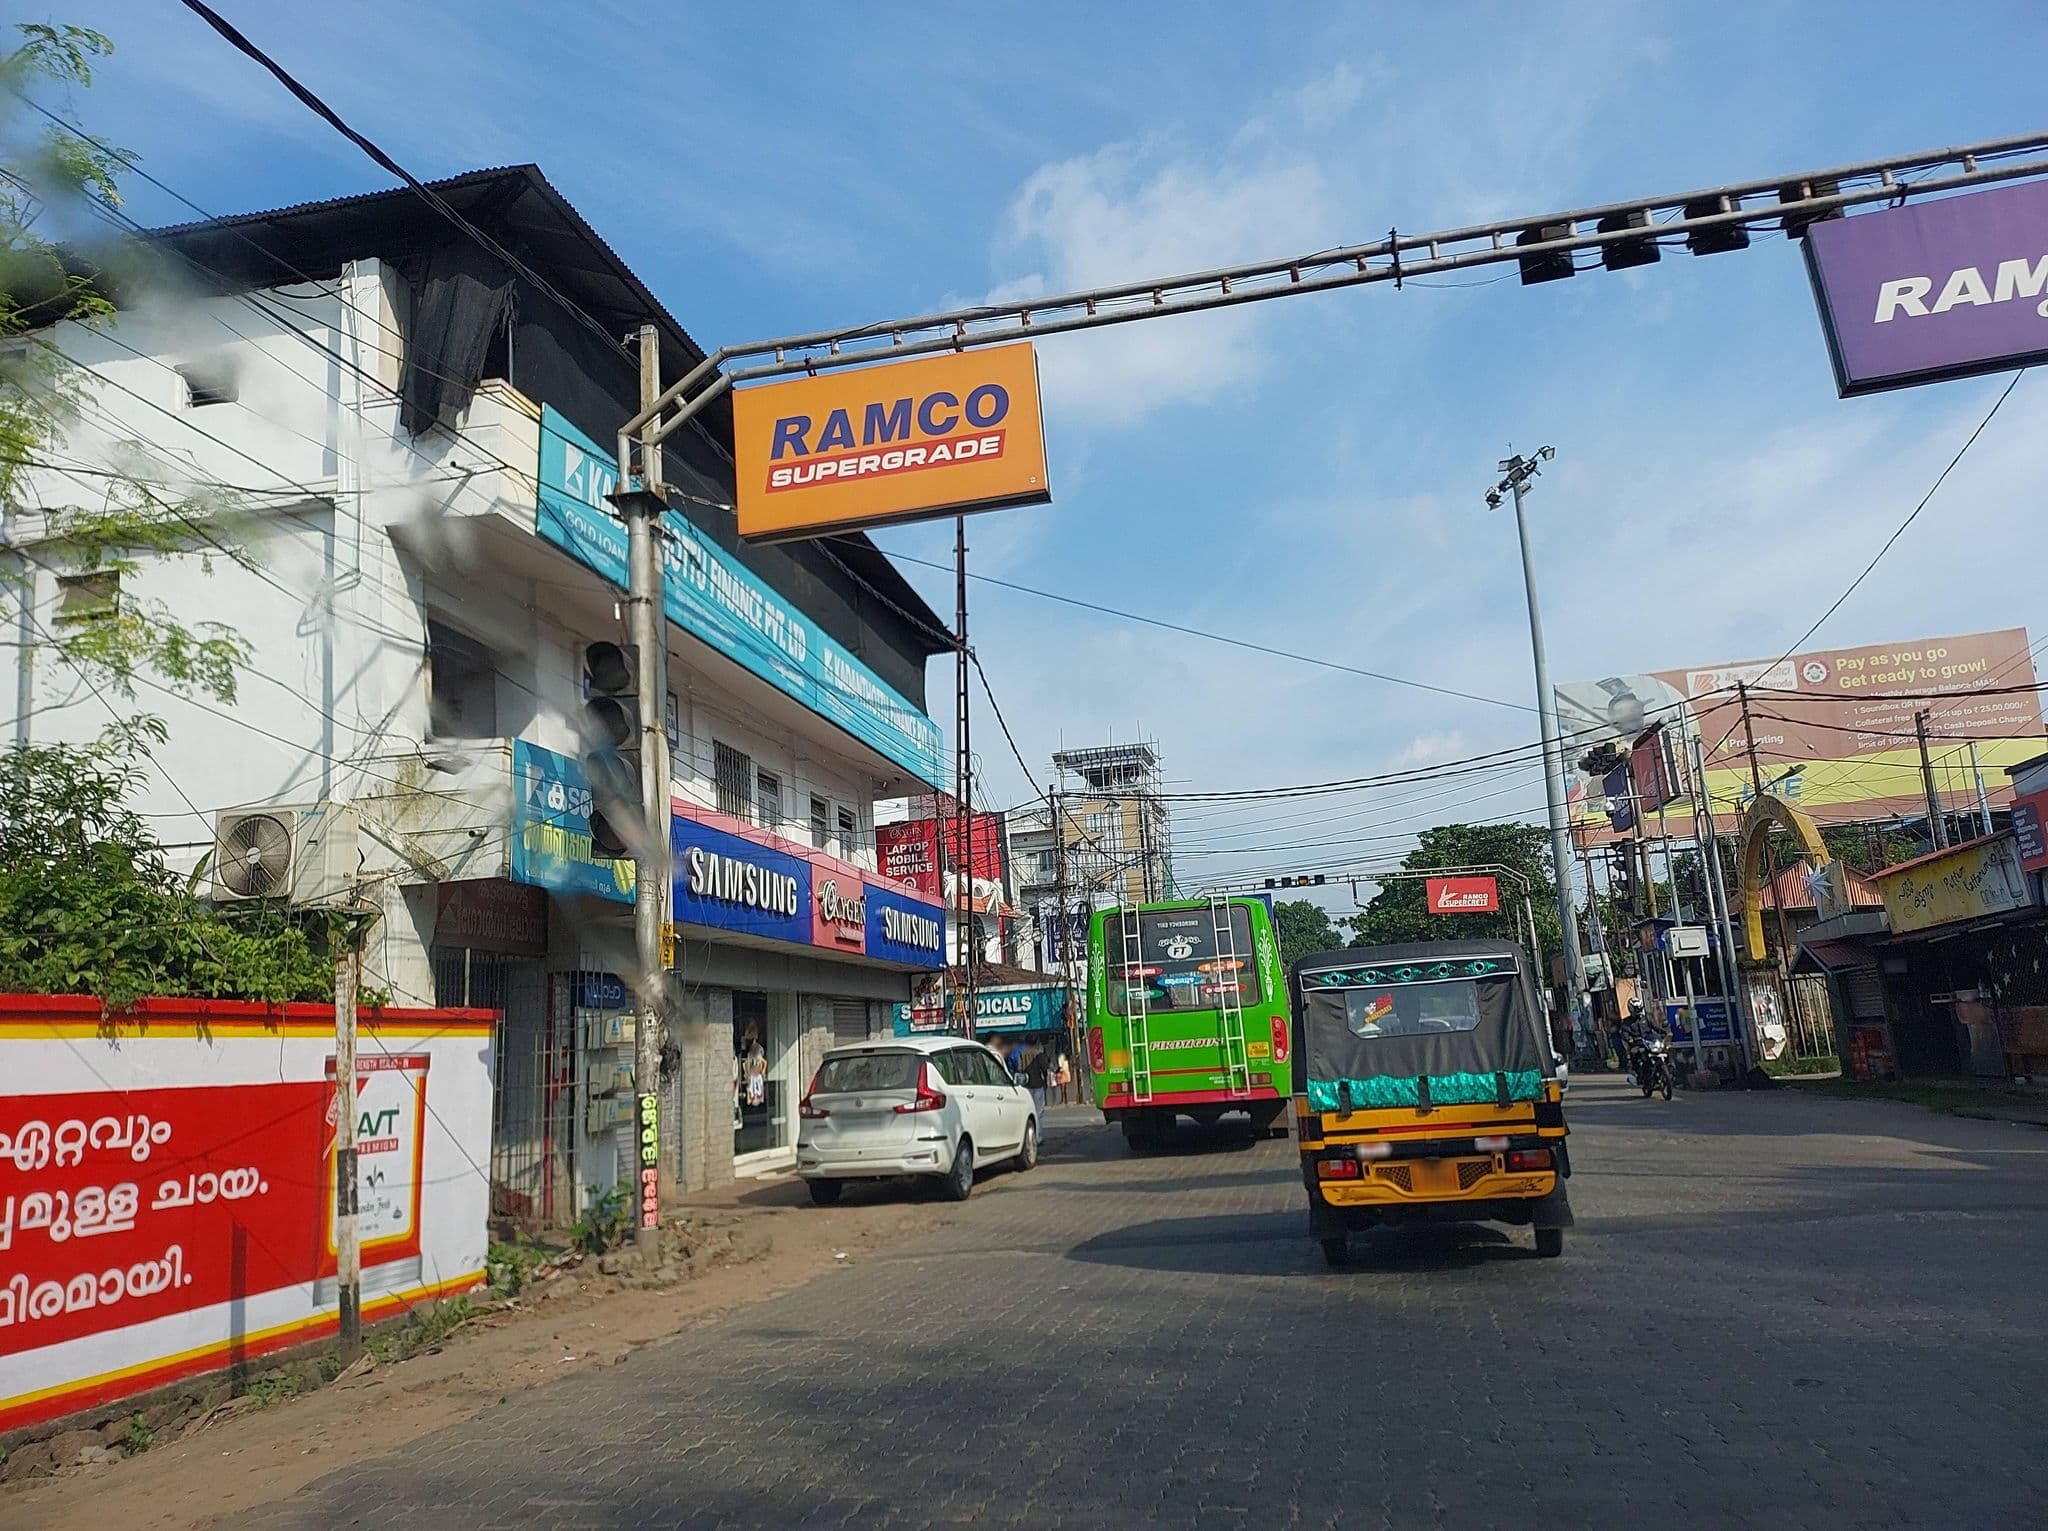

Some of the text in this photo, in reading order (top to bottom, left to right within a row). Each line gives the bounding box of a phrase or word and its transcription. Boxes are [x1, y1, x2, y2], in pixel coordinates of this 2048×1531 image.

[770, 383, 1010, 460] RAMCO
[771, 436, 1001, 488] SUPERGRADE
[565, 509, 596, 541] GOLD
[710, 557, 763, 632] FINANCE
[1836, 648, 1948, 672] Pay as you go
[1839, 658, 1988, 689] Get ready to grow!
[1904, 685, 1937, 696] Average
[1938, 682, 1971, 692] Balance
[1856, 715, 1893, 727] Collateral
[1894, 713, 1911, 723] free
[1951, 709, 1963, 718] up
[1964, 707, 1973, 715] to
[1860, 703, 1899, 714] Soundbox
[1914, 699, 1931, 707] free
[1944, 721, 1965, 730] Cash
[1966, 718, 1998, 729] Deposit
[1999, 714, 2033, 725] Charges
[1877, 738, 1886, 746] of
[885, 841, 929, 856] LAPTOP
[886, 853, 929, 866] MOBILE
[688, 846, 797, 916] SAMSUNG
[885, 862, 933, 877] SERVICE
[820, 879, 867, 926] OXYGEN
[1445, 899, 1489, 907] SUPERCRETE
[882, 906, 940, 951] SAMSUNG
[1172, 946, 1187, 957] FT
[357, 1108, 400, 1138] AVT
[0, 1114, 171, 1171] ഏറ്റവും
[152, 1167, 269, 1211] ചായ.
